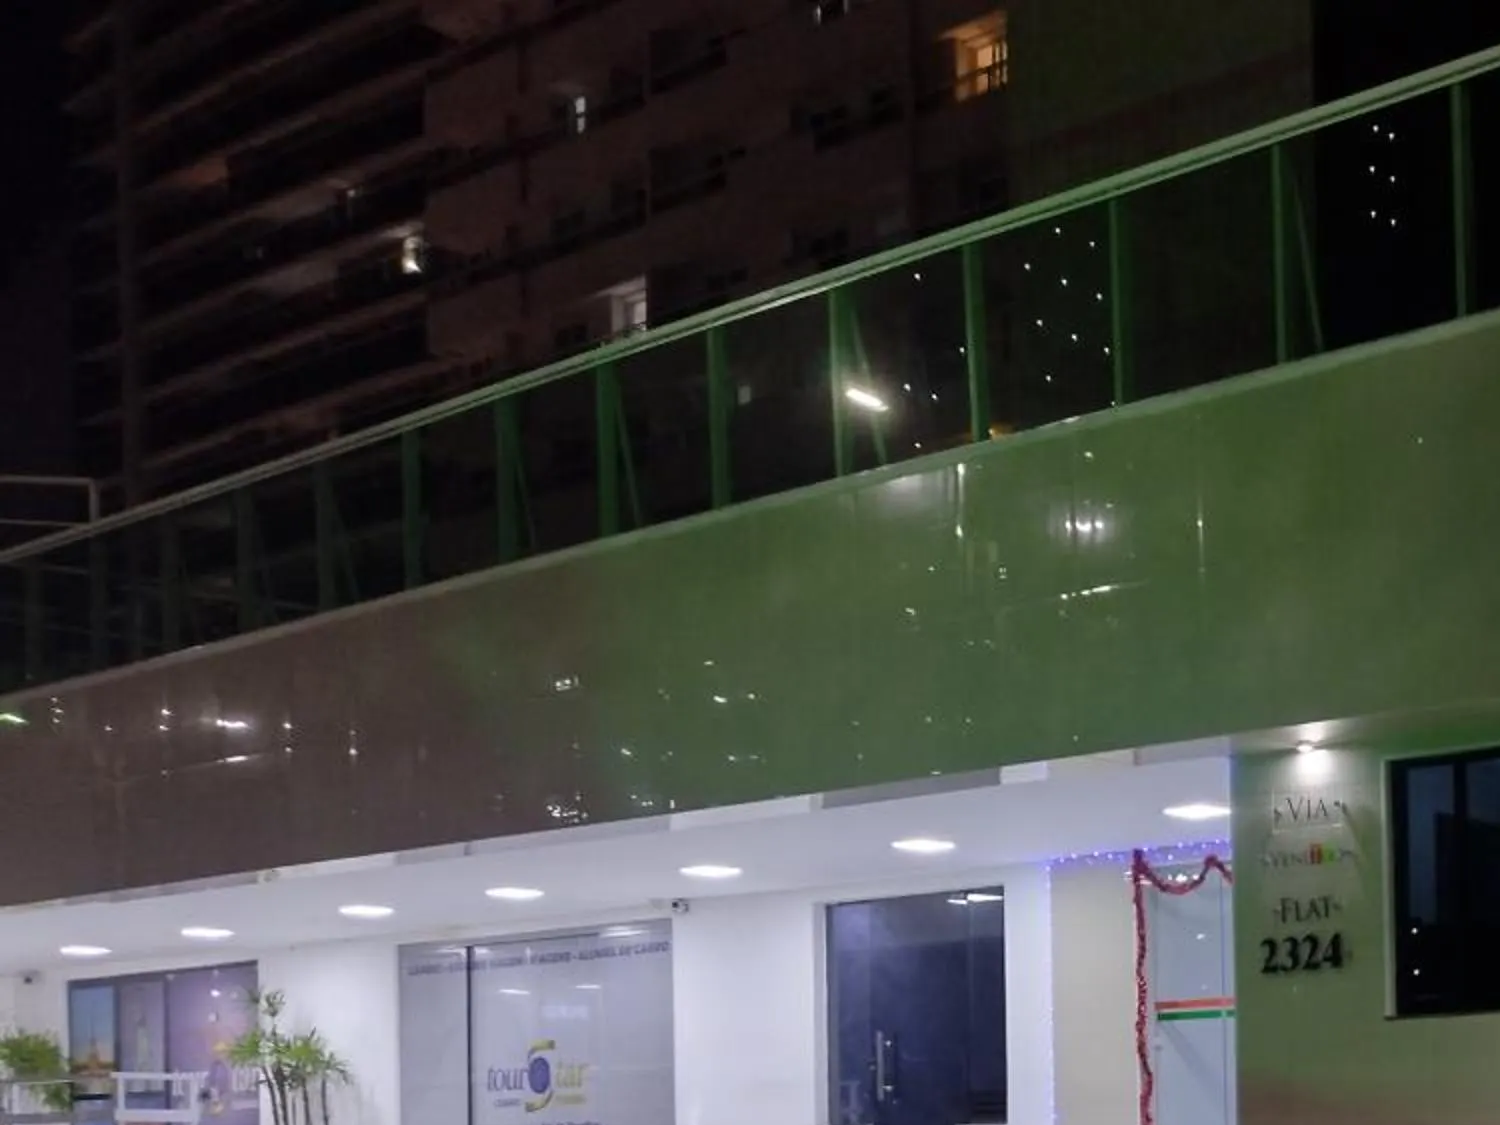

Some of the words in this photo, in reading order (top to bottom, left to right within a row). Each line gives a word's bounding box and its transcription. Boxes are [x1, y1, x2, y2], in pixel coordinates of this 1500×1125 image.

[1286, 796, 1329, 822] VIA
[1280, 896, 1332, 924] FLAT
[1260, 932, 1344, 974] 2324
